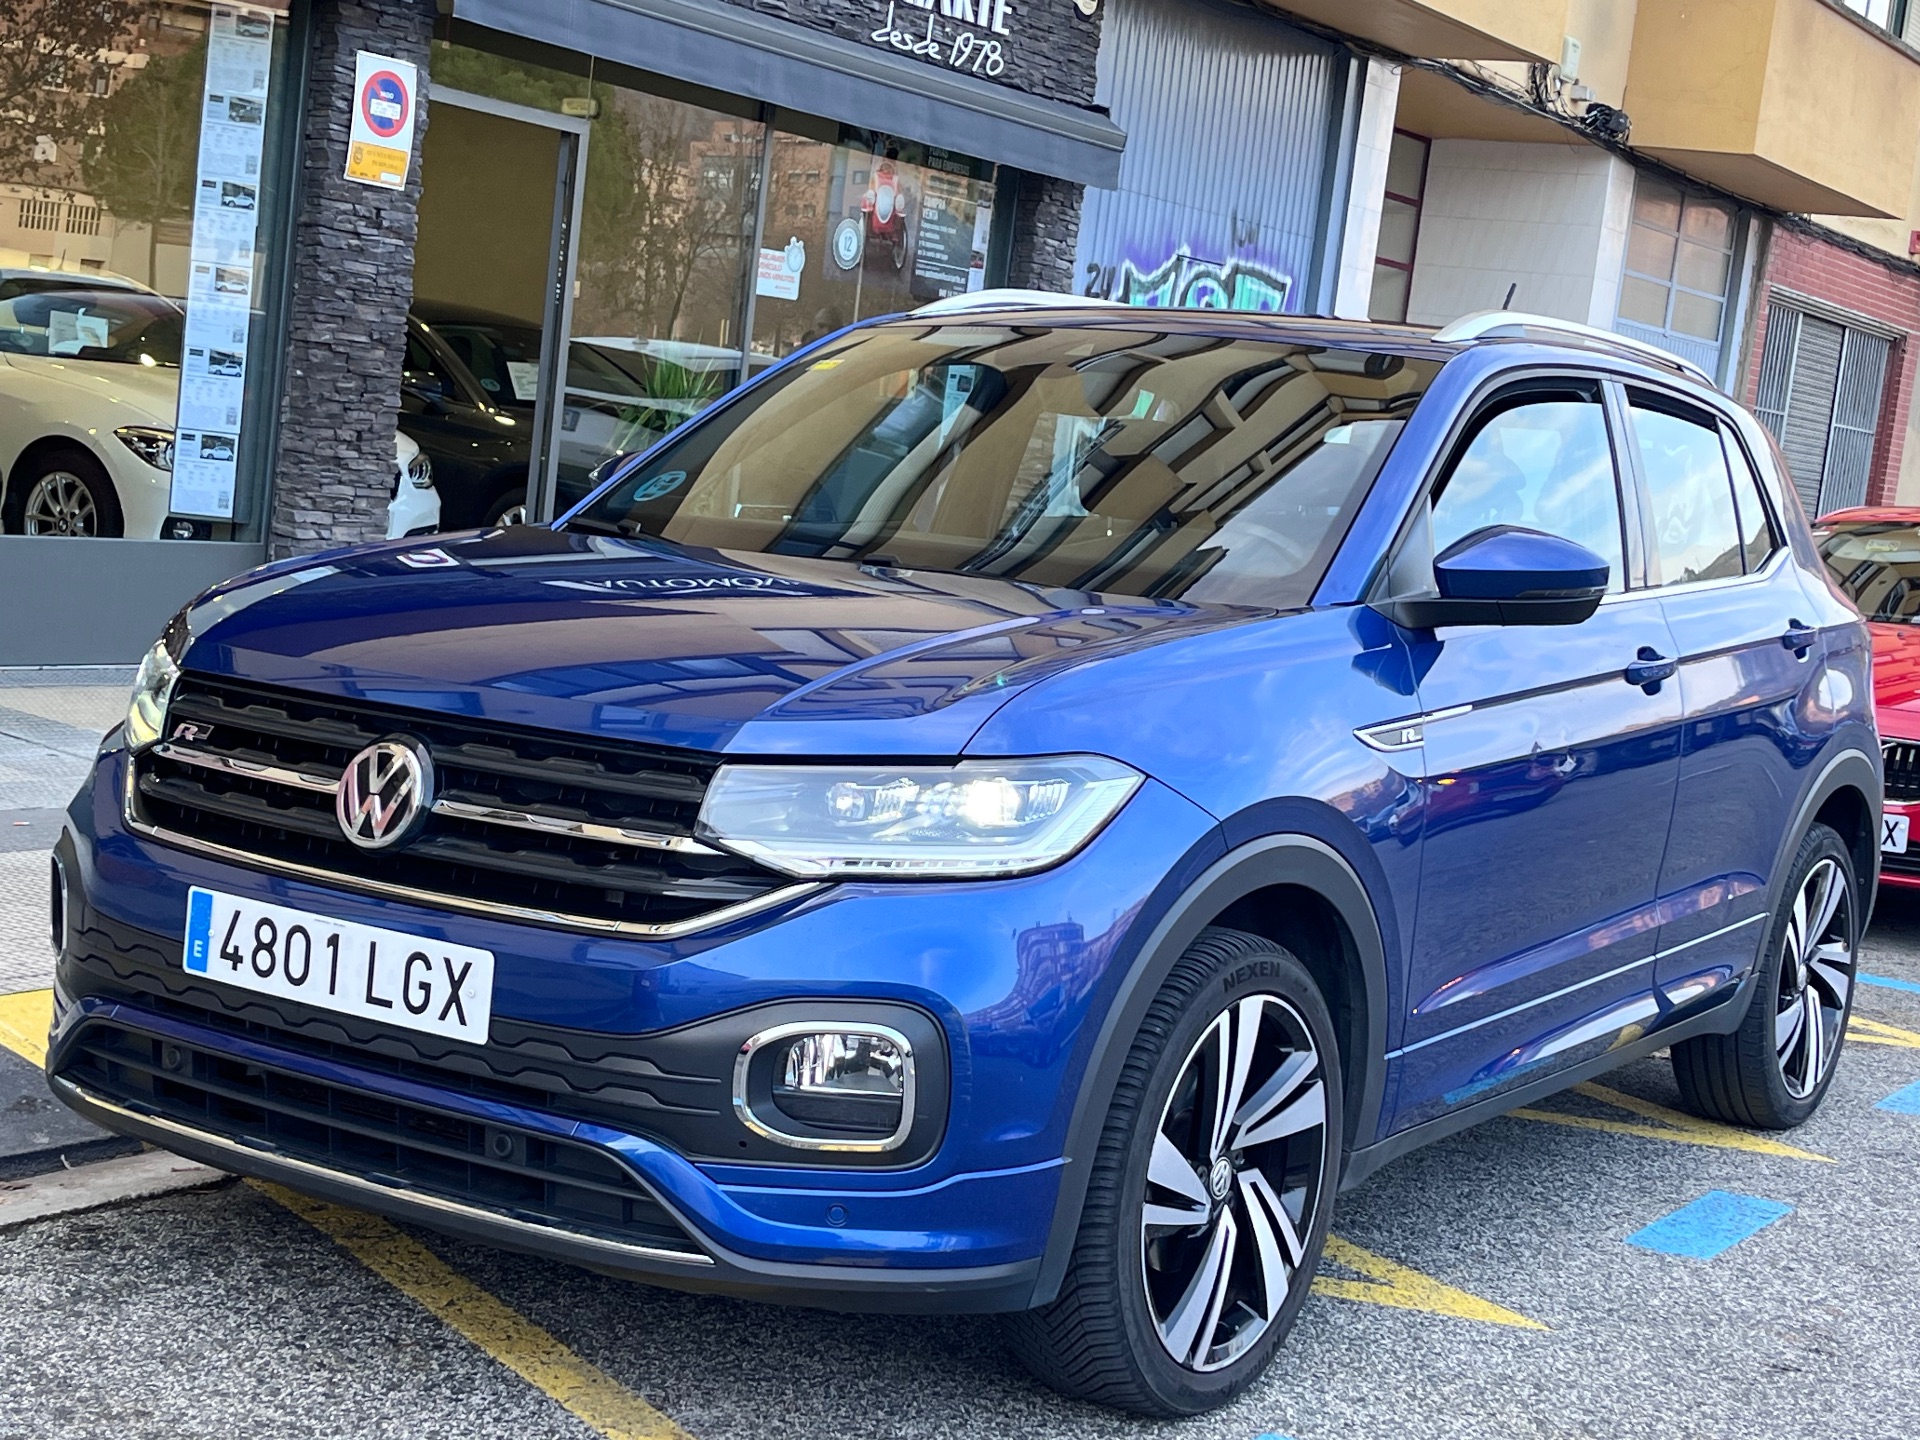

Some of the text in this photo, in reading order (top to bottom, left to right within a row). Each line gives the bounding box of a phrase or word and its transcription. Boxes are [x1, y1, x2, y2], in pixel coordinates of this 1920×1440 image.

[871, 1, 1005, 76] desde 1978
[844, 236, 853, 252] 12
[193, 939, 204, 958] E
[220, 910, 473, 1026] 4801 LGX
[1222, 961, 1281, 994] NEXEN
